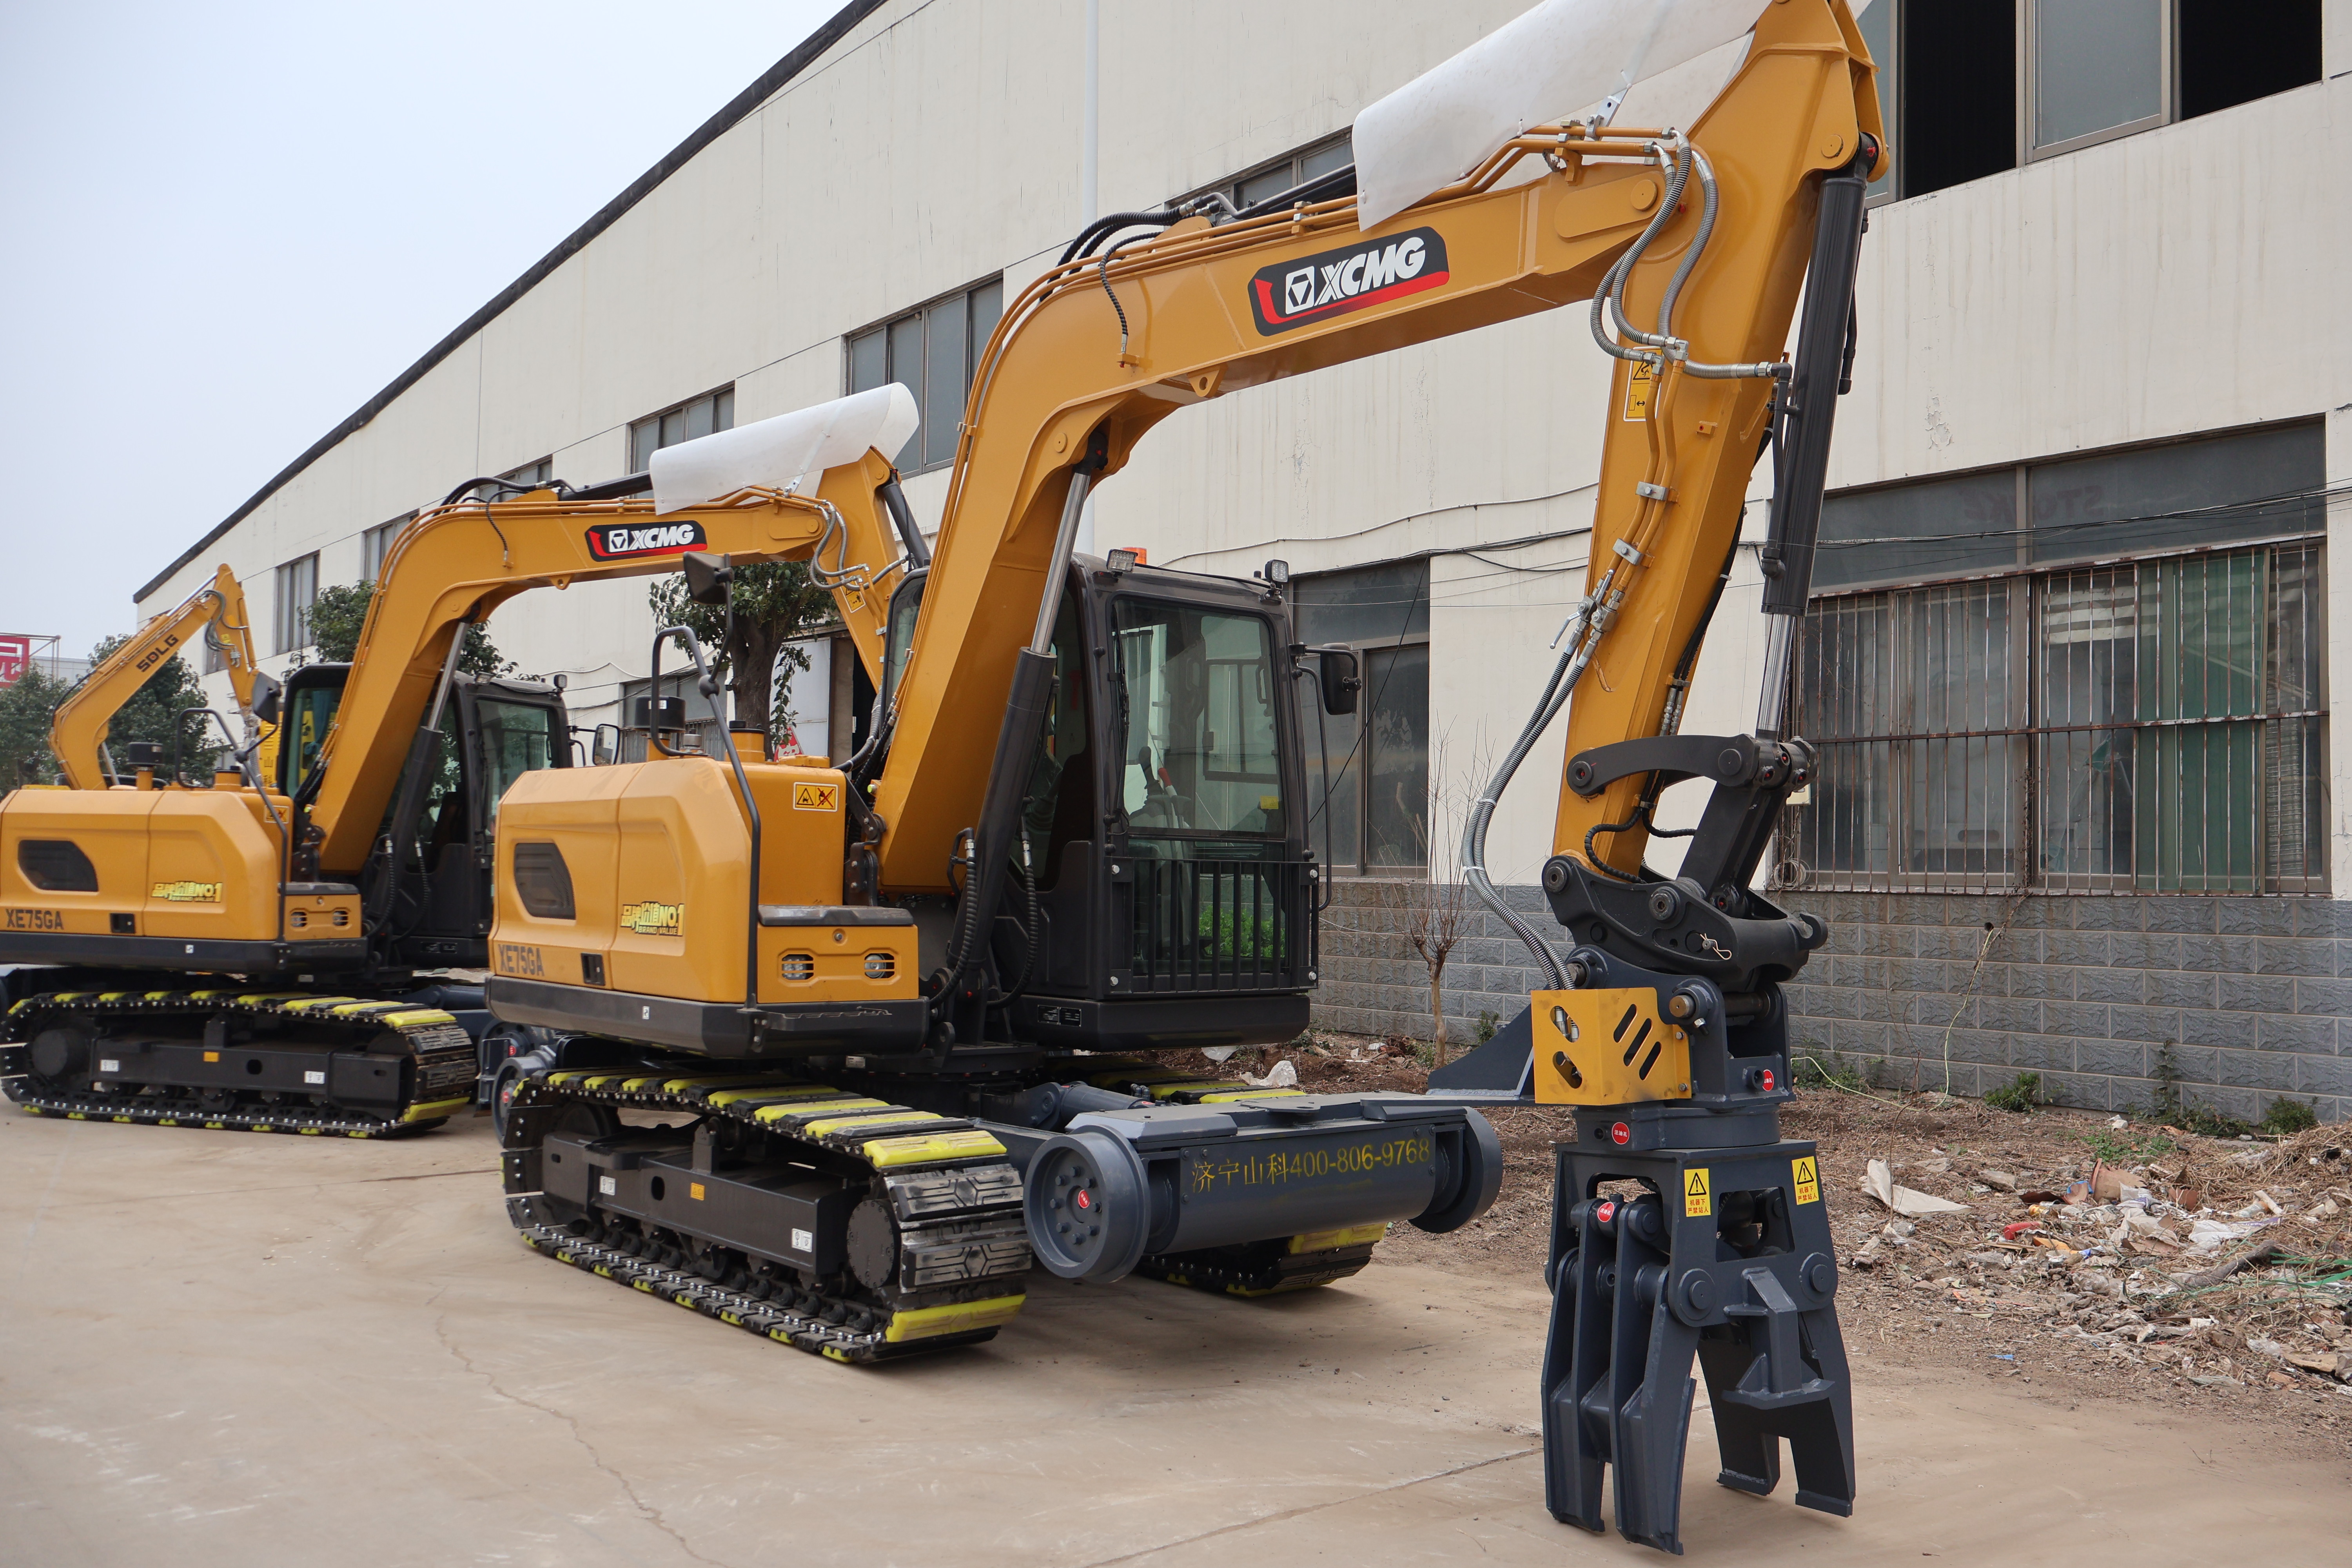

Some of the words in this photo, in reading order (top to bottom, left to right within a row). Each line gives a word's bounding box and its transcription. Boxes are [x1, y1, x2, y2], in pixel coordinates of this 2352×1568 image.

[1315, 237, 1426, 306] XCMG
[628, 524, 695, 550] XCMG
[136, 634, 179, 672] SDLG
[6, 909, 64, 930] XE75GA
[639, 926, 658, 935] BRAND
[659, 927, 678, 936] VALUE
[498, 944, 545, 976] XE75GA
[1797, 1192, 1817, 1203] 严禁站人
[1799, 1185, 1814, 1194] 机器下
[1688, 1206, 1709, 1215] 严禁站人
